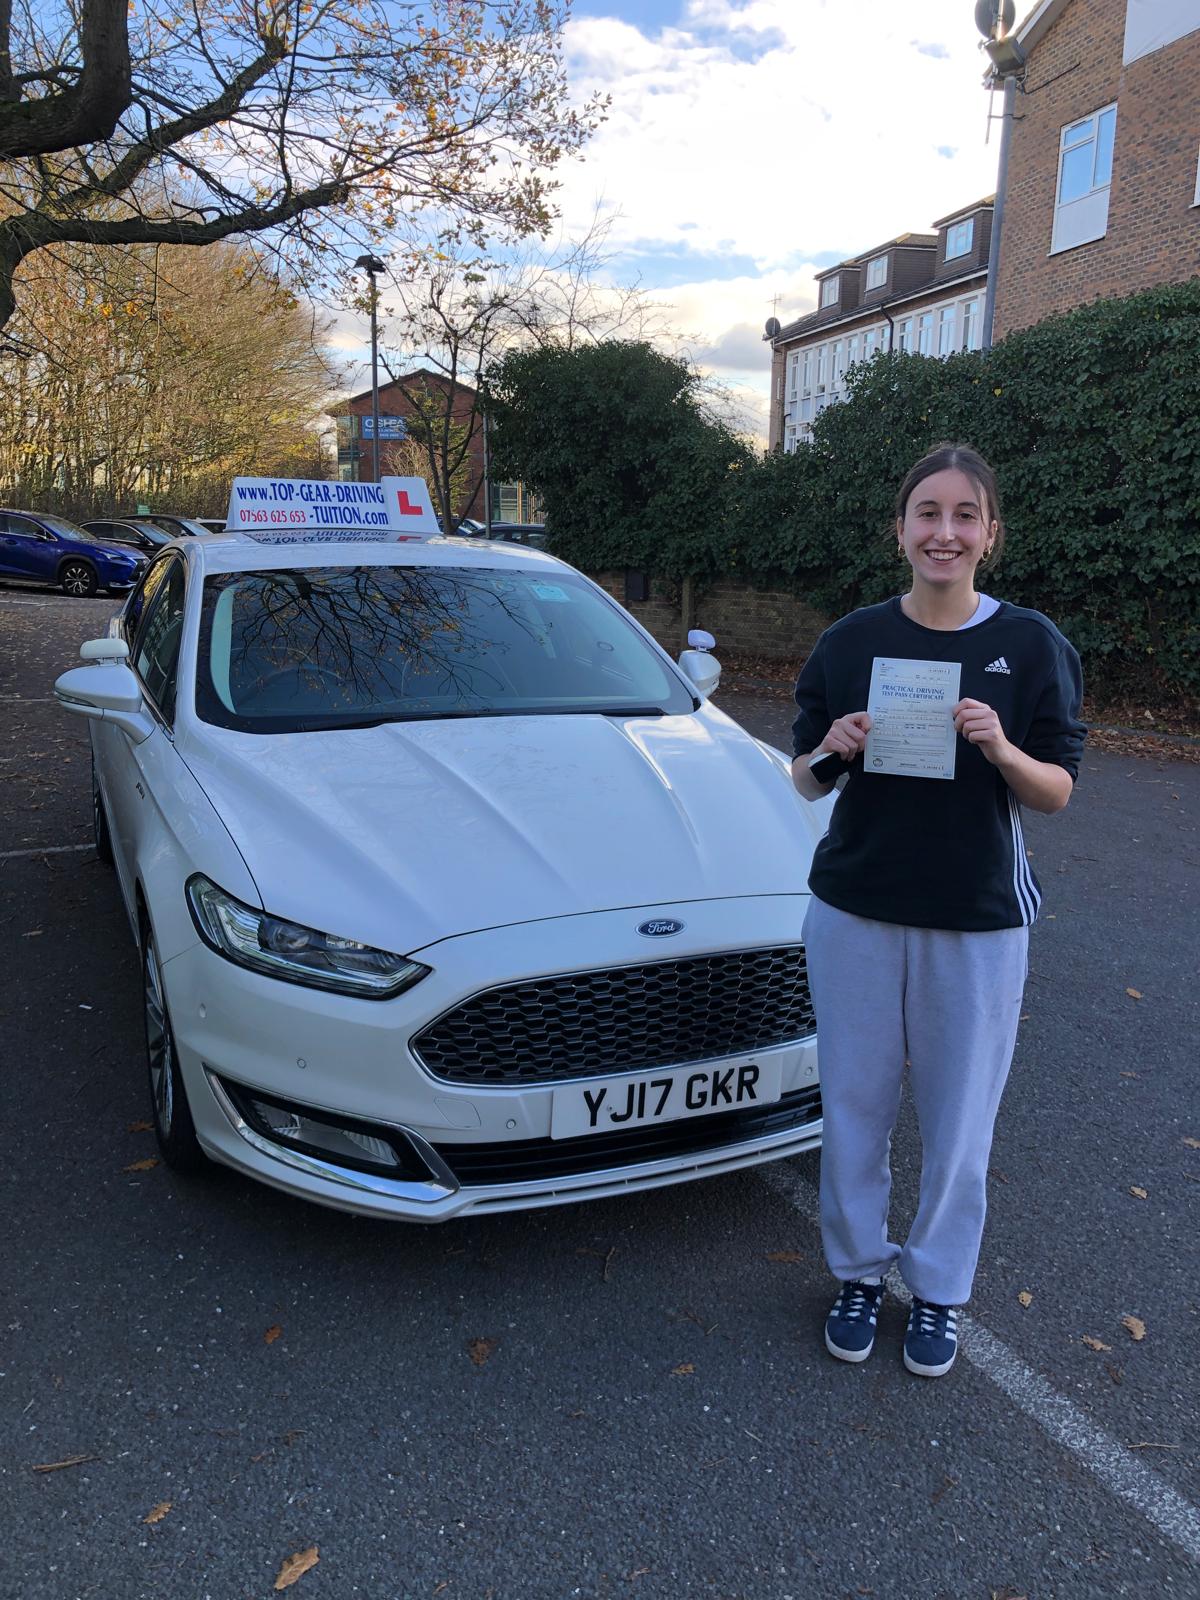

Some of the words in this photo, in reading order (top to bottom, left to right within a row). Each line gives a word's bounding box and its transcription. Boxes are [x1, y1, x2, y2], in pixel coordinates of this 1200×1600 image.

[237, 483, 385, 503] www.TOP-GEAR-DRIVING
[397, 491, 423, 515] L
[240, 509, 268, 523] 07563
[271, 510, 287, 523] 625
[289, 510, 306, 523] 653
[309, 506, 389, 525] -TUITION.com
[984, 666, 1011, 674] adidas
[882, 684, 914, 693] PRACTICAL
[916, 687, 945, 695] DRIVING
[909, 692, 944, 700] CERTIFICATE
[647, 921, 676, 934] Ford
[583, 1078, 673, 1127] YJ17
[685, 1064, 760, 1110] GKR
